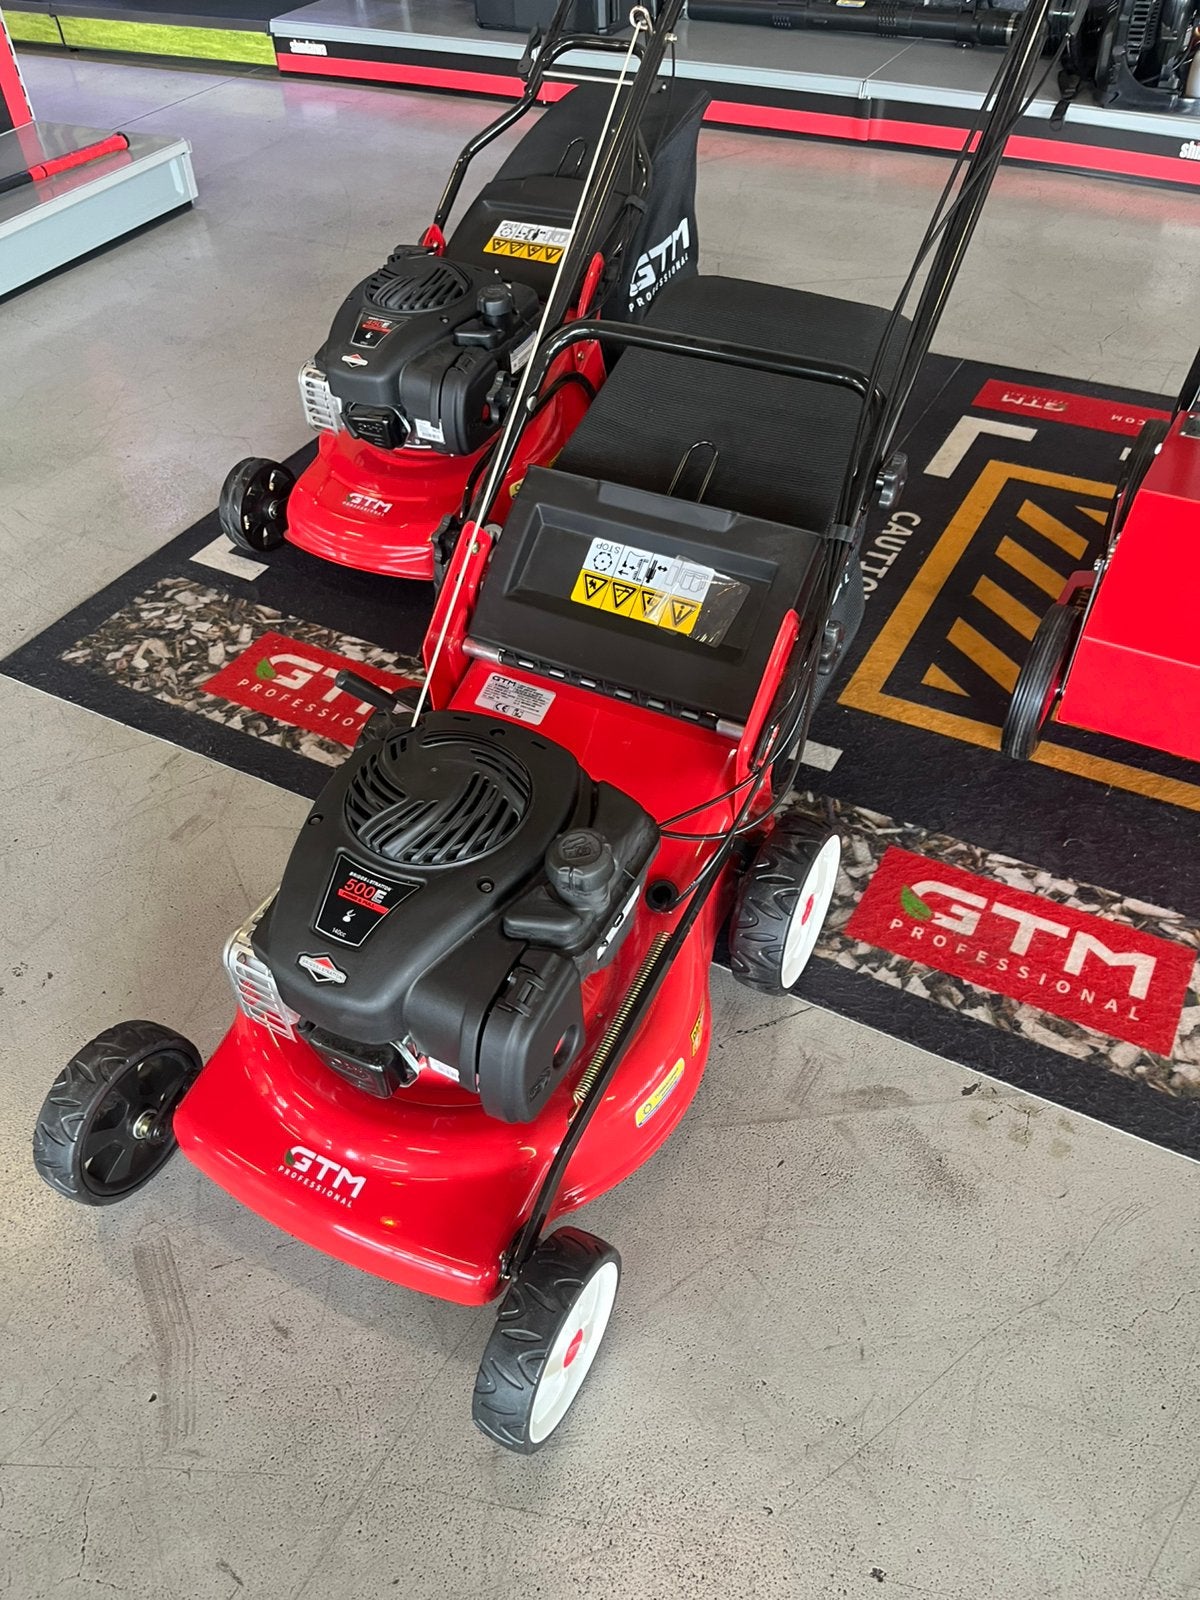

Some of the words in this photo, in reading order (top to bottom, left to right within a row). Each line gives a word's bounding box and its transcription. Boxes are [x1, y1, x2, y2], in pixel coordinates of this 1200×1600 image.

[629, 217, 690, 297] GTM
[628, 252, 689, 313] PROFESSIONAL
[1001, 394, 1068, 412] GTM
[346, 492, 393, 513] GTM
[596, 542, 621, 554] STOP
[860, 511, 922, 601] CAUTIO
[492, 675, 517, 687] GTM
[344, 878, 388, 904] 500E
[901, 880, 1157, 1000] GTM
[889, 918, 1140, 1021] PROFESSIONAL
[277, 1164, 353, 1208] PROFESSIONAL
[285, 1145, 367, 1199] GTM
